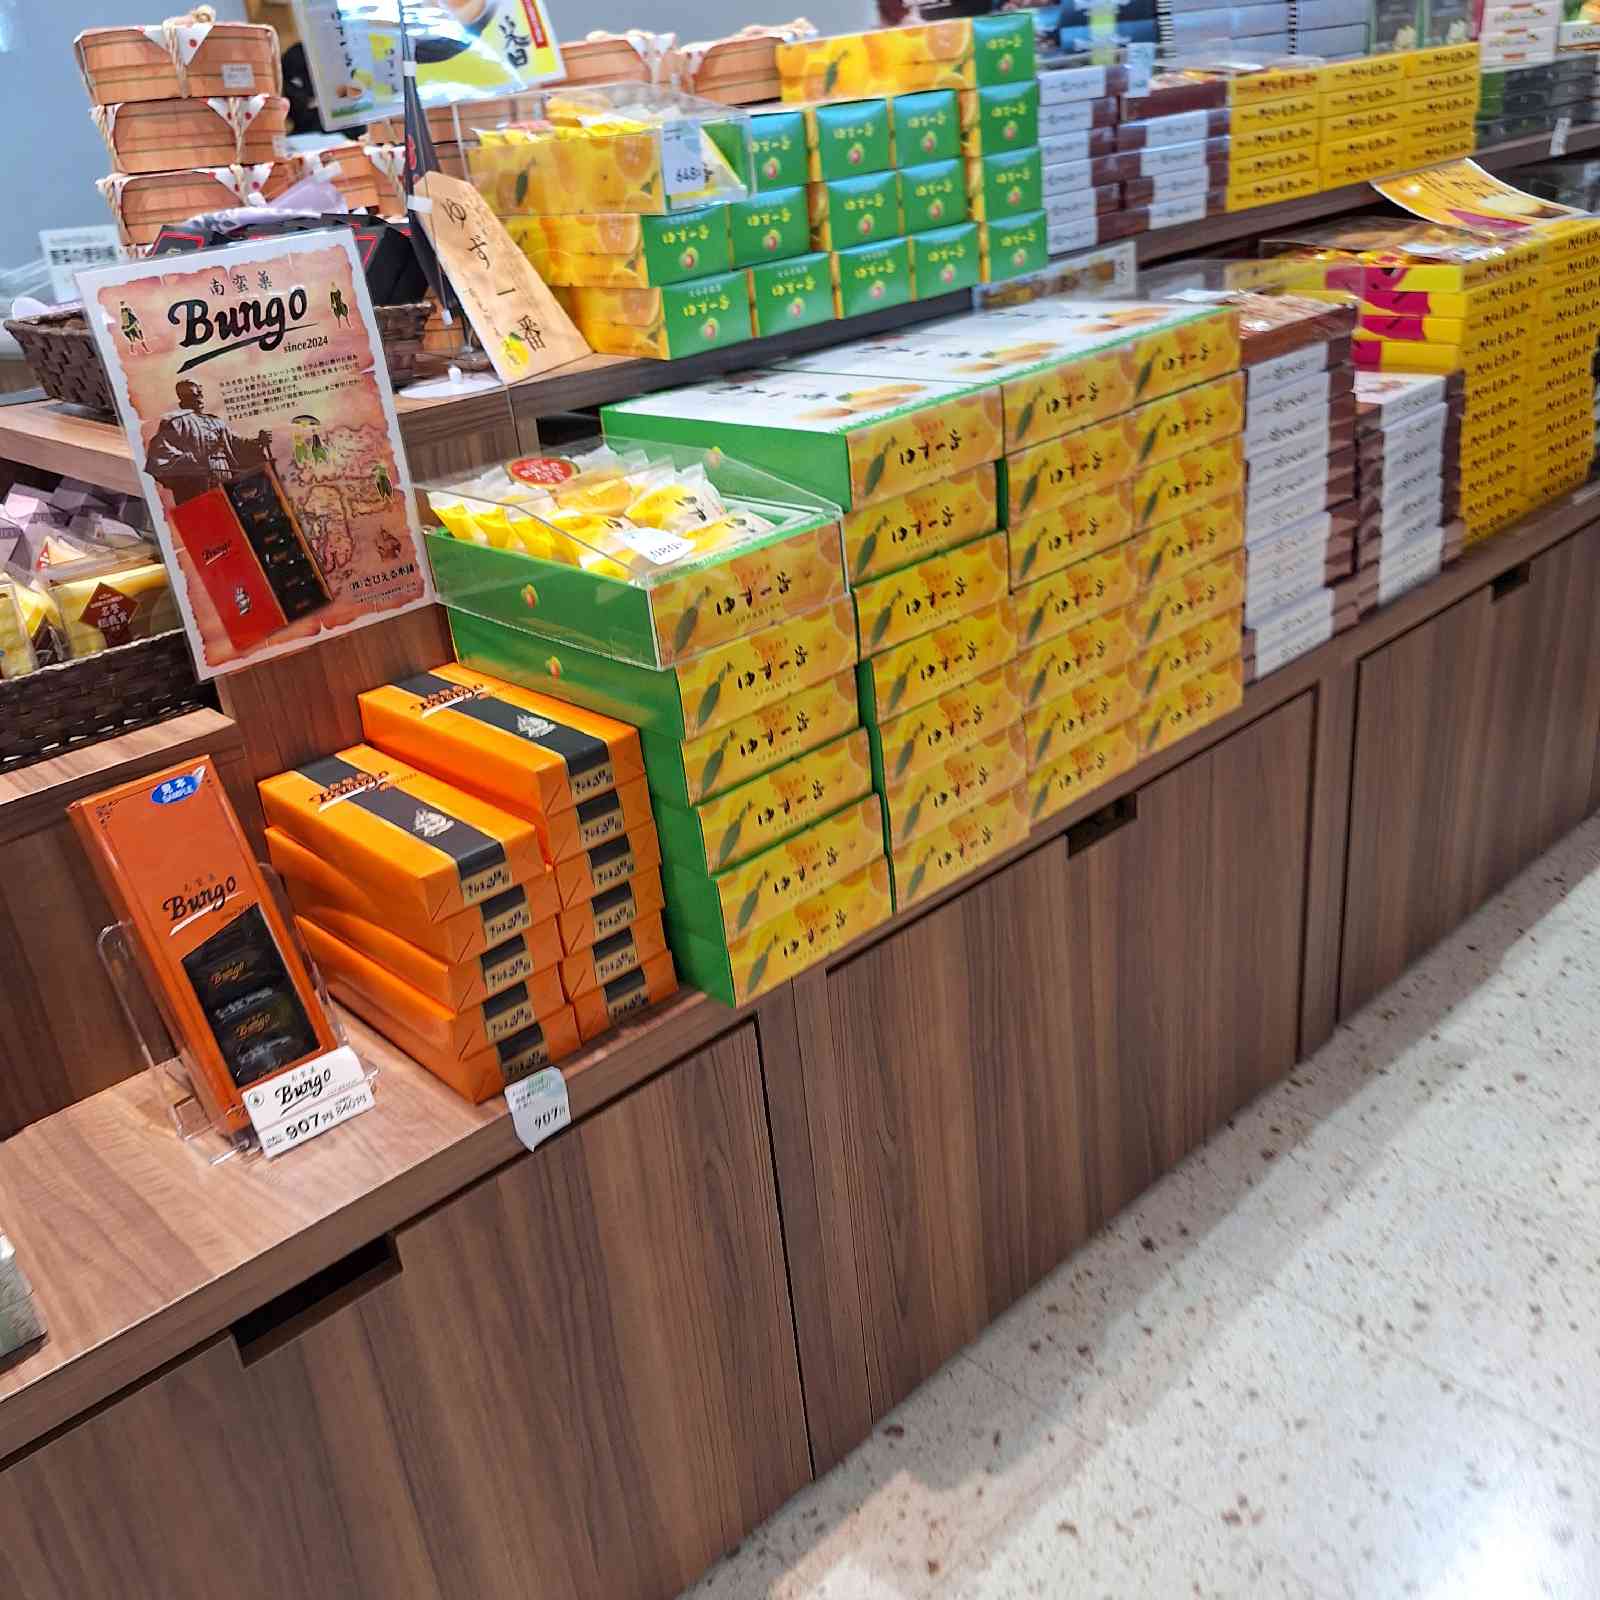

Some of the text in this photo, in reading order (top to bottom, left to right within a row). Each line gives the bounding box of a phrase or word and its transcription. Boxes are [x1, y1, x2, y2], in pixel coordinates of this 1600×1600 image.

[167, 288, 308, 352] Bungo
[283, 336, 329, 353] since2024
[162, 876, 236, 921] Bungo
[275, 1068, 331, 1105] Bungo
